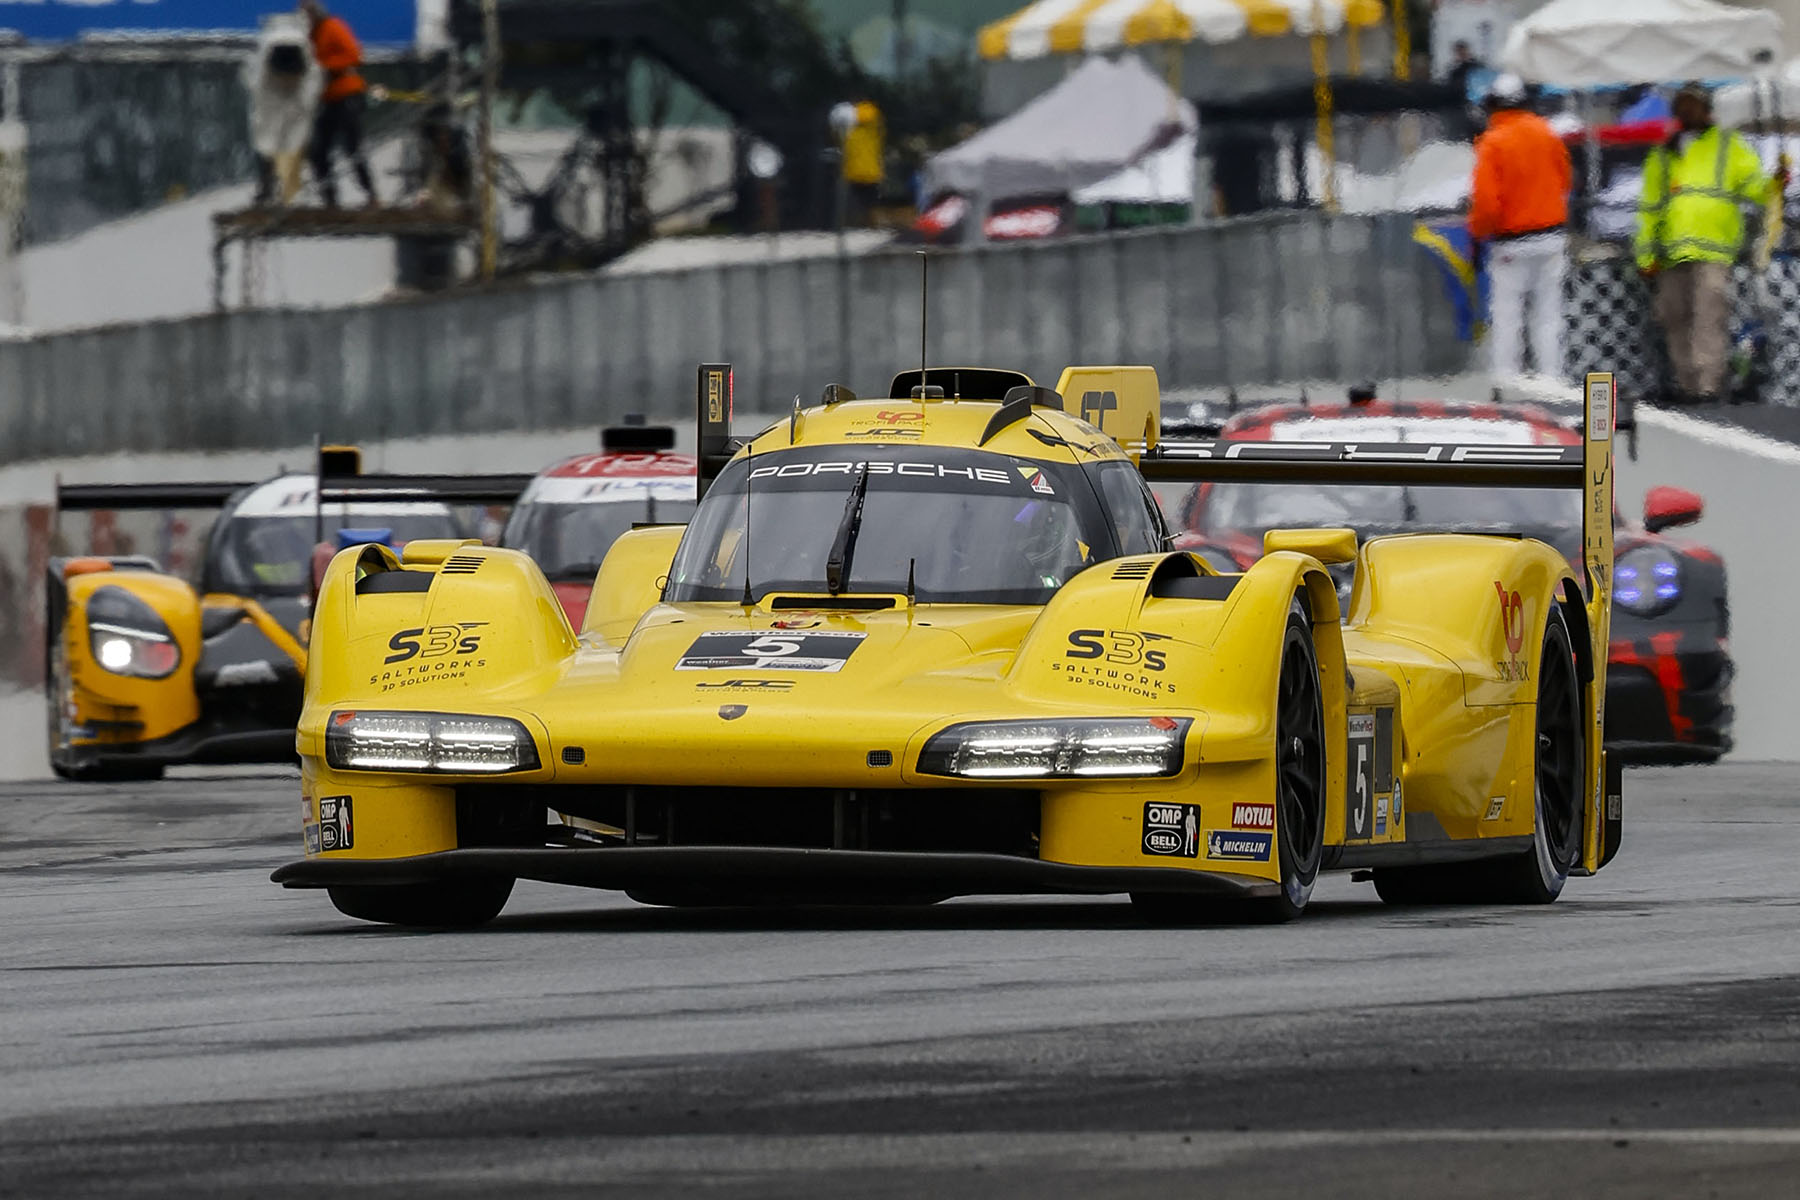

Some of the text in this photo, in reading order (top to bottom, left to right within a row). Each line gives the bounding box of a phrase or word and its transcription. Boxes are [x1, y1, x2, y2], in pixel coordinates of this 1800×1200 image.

[748, 461, 1011, 484] PORSCHE
[741, 636, 806, 656] 5
[370, 659, 486, 685] SALTWORKS
[381, 671, 466, 693] 3D SOLUTIONS
[1052, 663, 1176, 694] SALTWORKS
[1067, 675, 1158, 700] 3D SOLUTIONS
[1354, 743, 1367, 834] 5
[321, 803, 336, 819] OMP
[1148, 807, 1182, 824] OMP
[1233, 806, 1273, 826] MOTUL
[1150, 835, 1177, 847] BELL
[1222, 840, 1267, 853] MICHELIN
